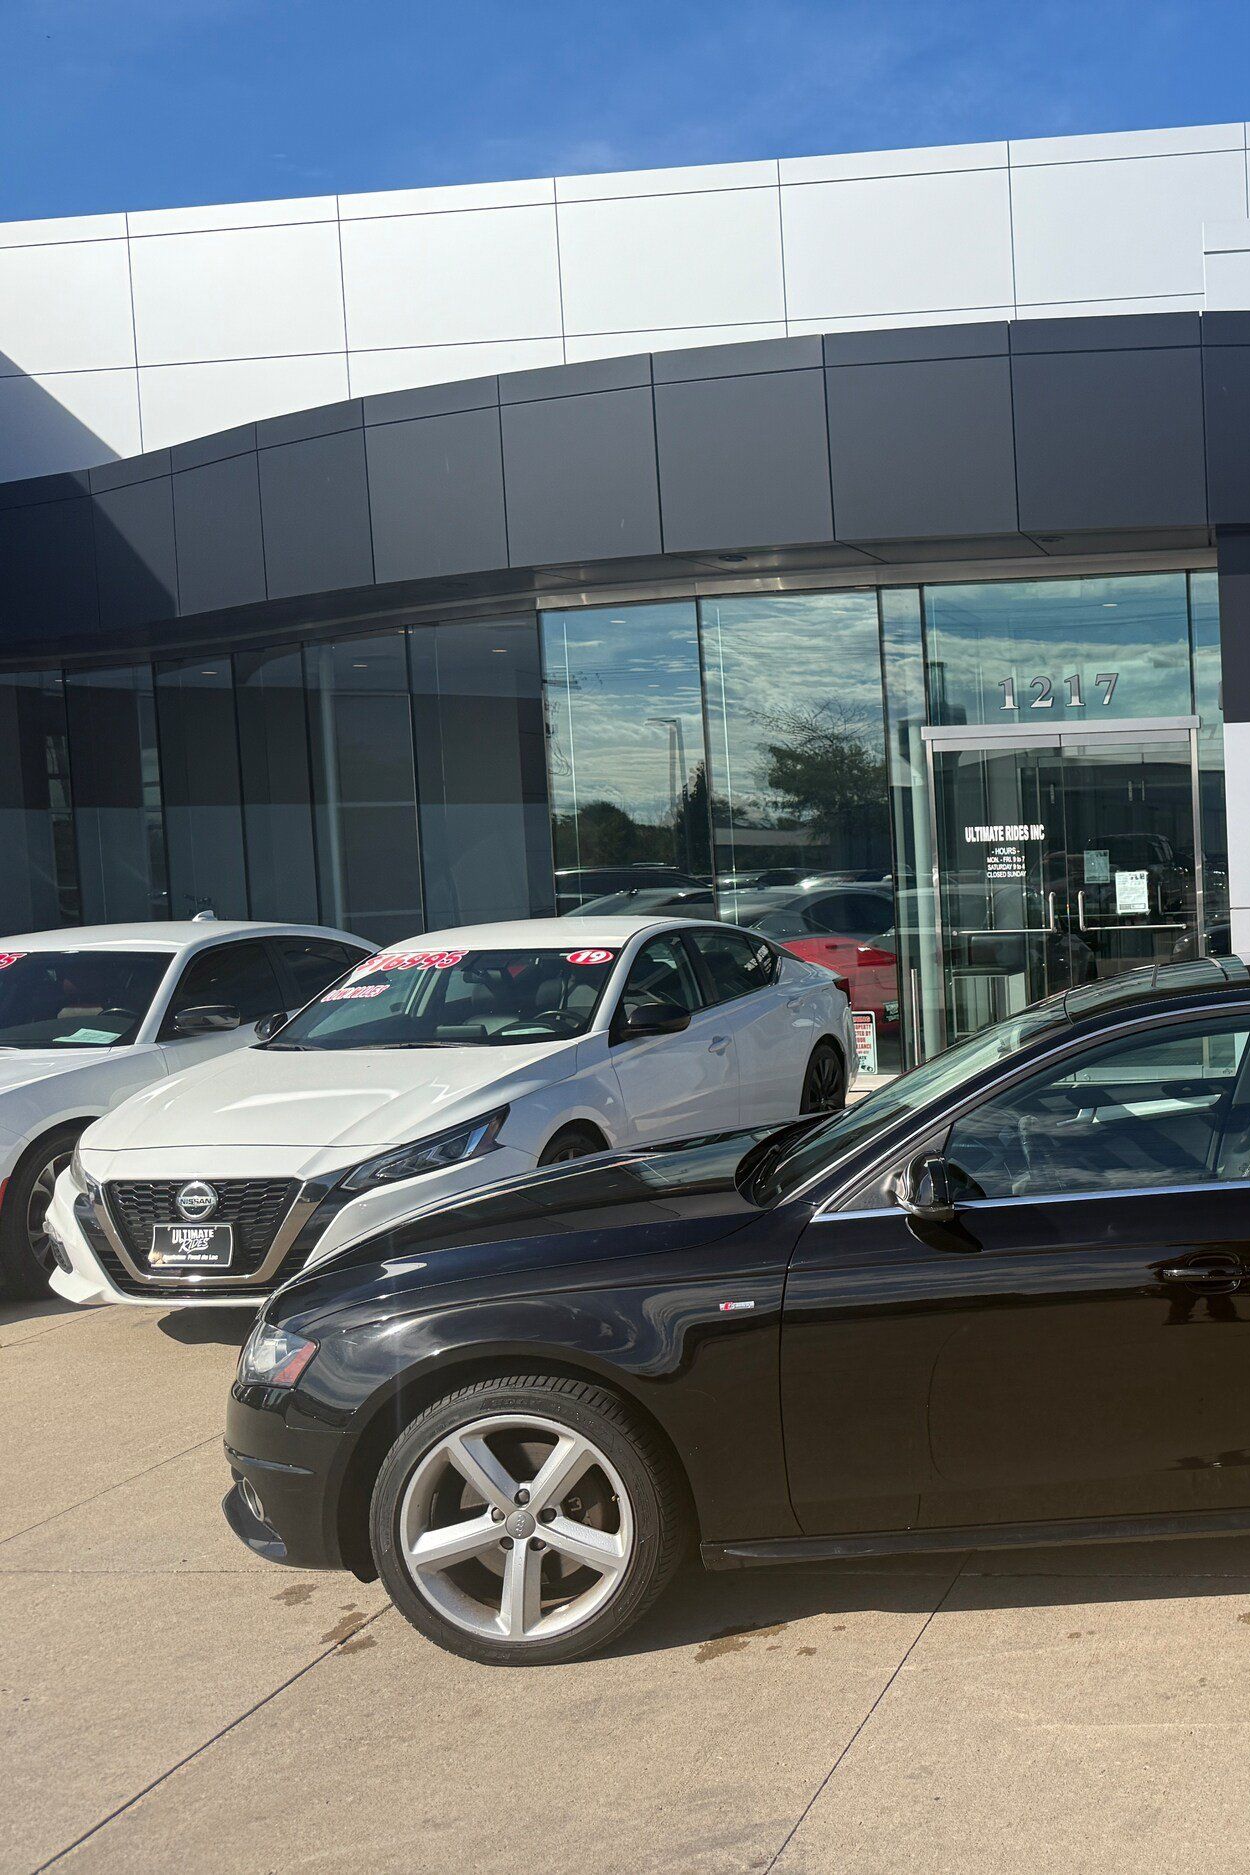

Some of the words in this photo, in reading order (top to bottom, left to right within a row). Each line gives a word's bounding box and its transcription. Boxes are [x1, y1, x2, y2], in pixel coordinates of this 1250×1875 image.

[998, 672, 1119, 711] 1217
[965, 826, 1004, 842] ULTIMATE
[1005, 825, 1029, 841] RIDES
[1030, 824, 1045, 840] INC
[995, 847, 1017, 855] HOURS
[1007, 870, 1027, 878] SUNDAY
[576, 951, 606, 962] 19
[172, 1229, 214, 1244] ULTIMATE
